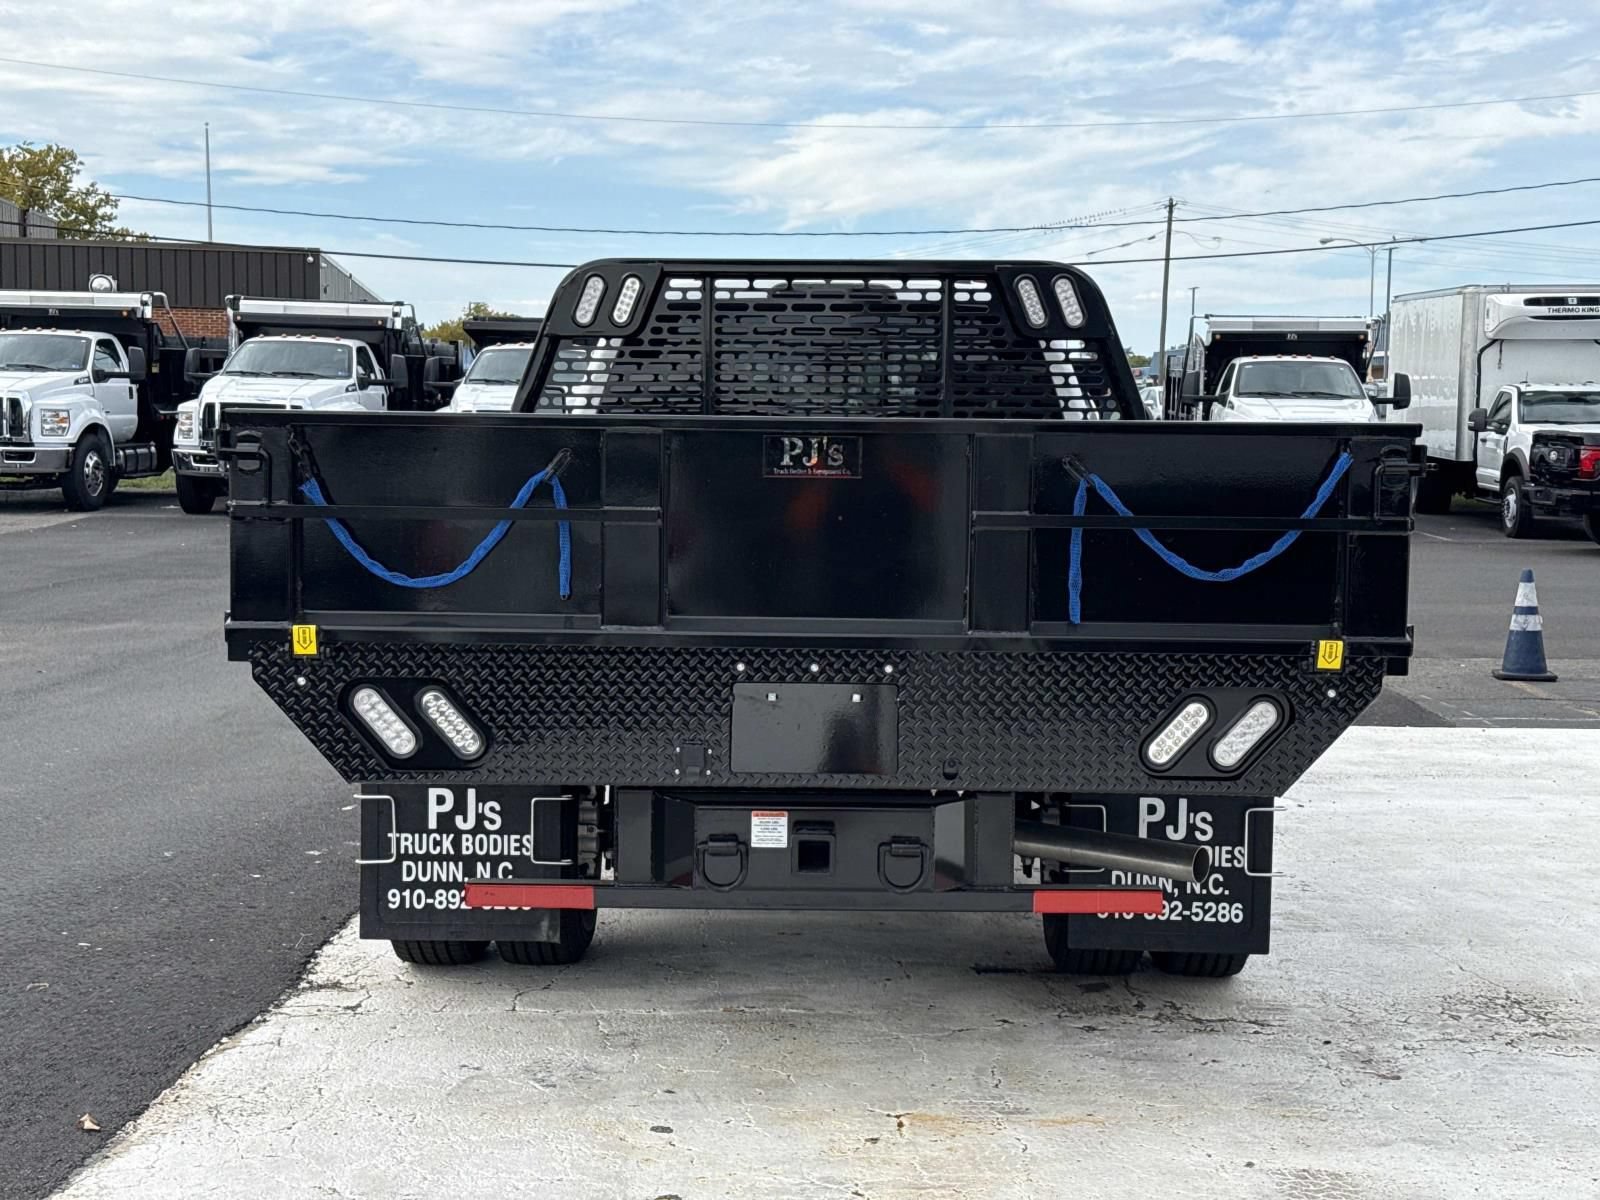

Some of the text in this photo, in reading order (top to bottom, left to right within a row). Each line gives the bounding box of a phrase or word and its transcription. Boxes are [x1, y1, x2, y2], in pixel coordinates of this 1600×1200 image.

[780, 435, 844, 466] PJ's
[387, 833, 532, 856] TRUCK BODIES
